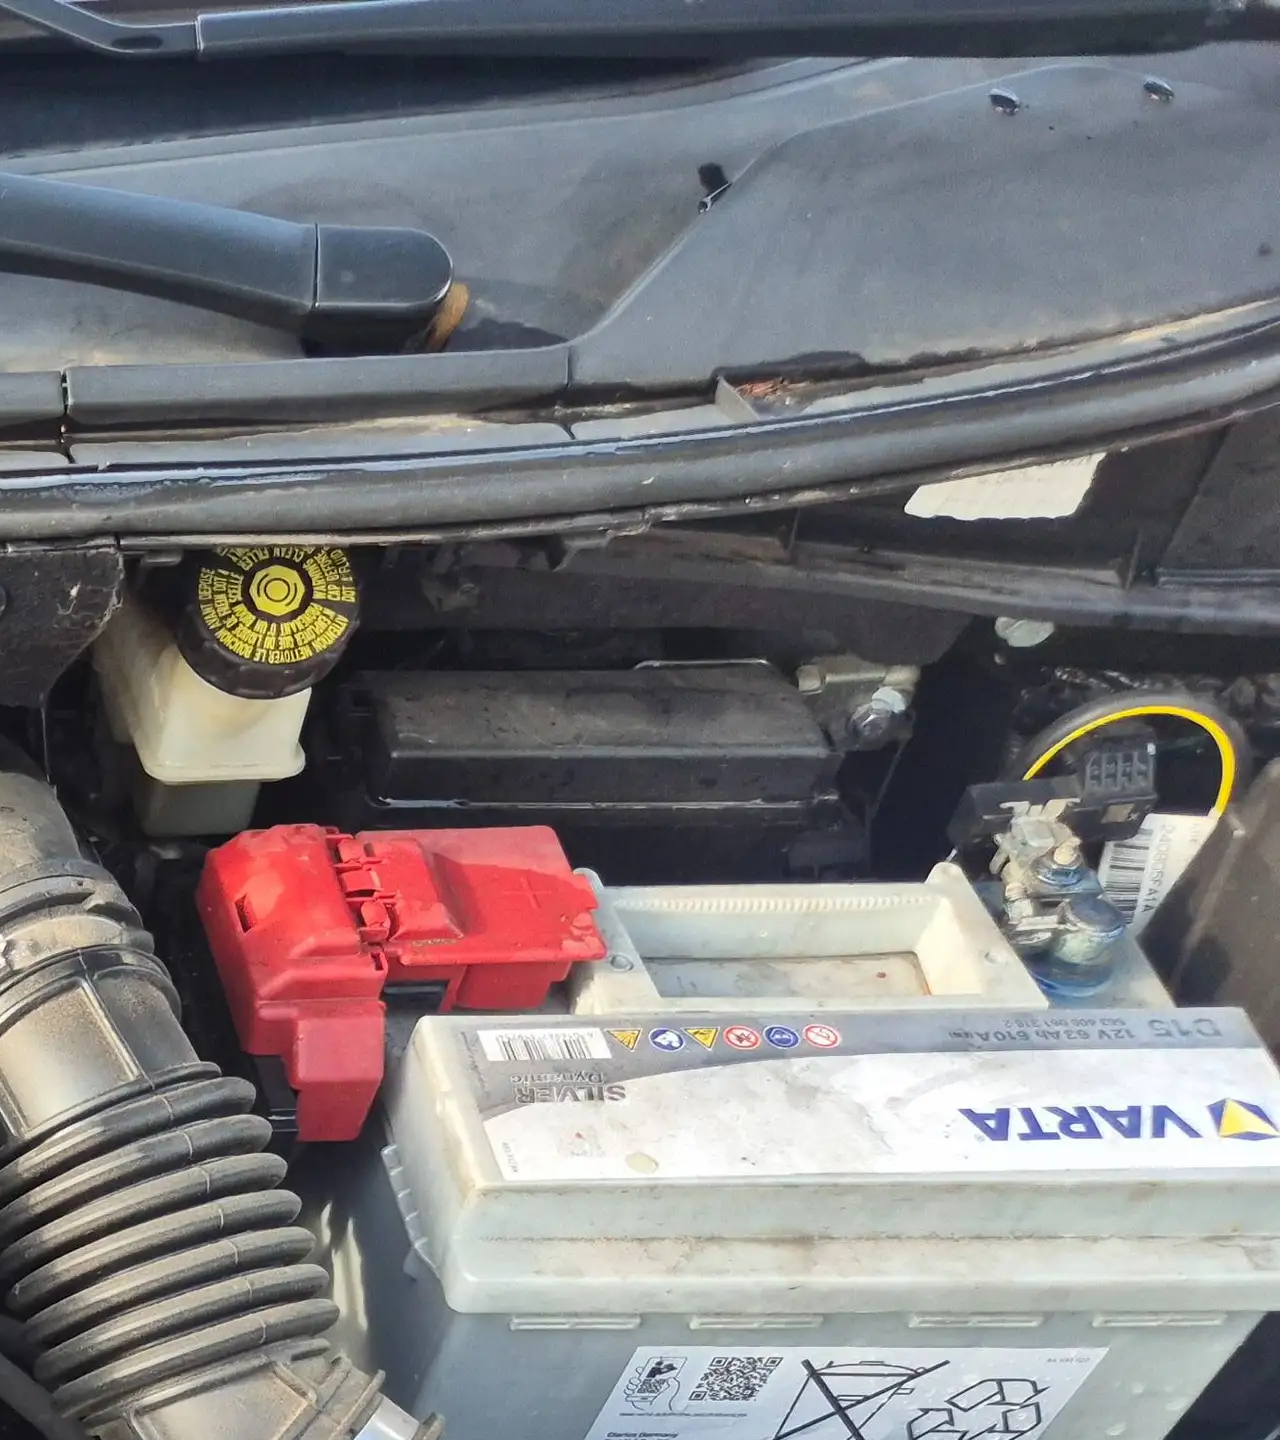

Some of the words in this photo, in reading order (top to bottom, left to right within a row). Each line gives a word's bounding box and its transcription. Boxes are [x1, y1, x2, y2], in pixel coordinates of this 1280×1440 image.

[341, 586, 356, 602] DOT
[253, 648, 267, 663] LE
[509, 1071, 604, 1086] Dynamic
[514, 1084, 627, 1104] SILVER
[958, 1104, 1203, 1142] VARTA
